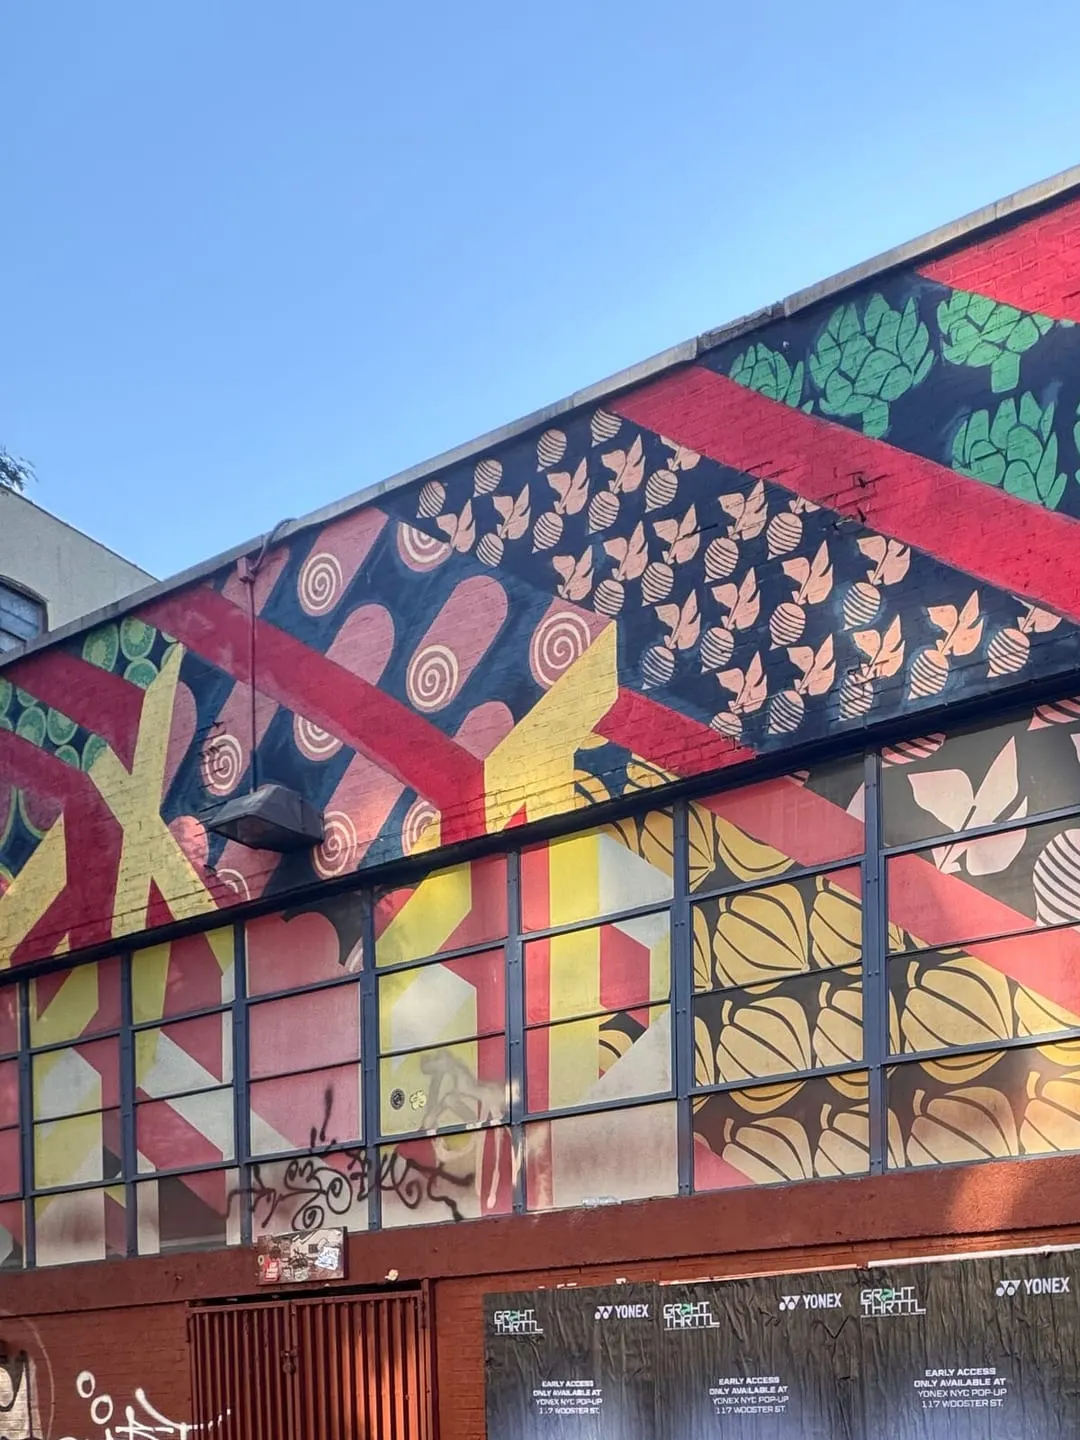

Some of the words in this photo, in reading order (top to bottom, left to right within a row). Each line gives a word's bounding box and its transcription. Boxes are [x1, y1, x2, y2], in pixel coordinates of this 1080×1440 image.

[1024, 1277, 1070, 1294] YONEX
[803, 1293, 842, 1309] YONEX
[861, 1299, 926, 1314] THRTTL
[615, 1304, 648, 1318] YONEX
[664, 1313, 720, 1328] THRTTL
[940, 1378, 990, 1386] AVAILABLE
[732, 1386, 776, 1394] AVAILABLE
[950, 1389, 969, 1397] NYC
[972, 1388, 1007, 1396] POP-UP
[713, 1397, 739, 1405] YONEX
